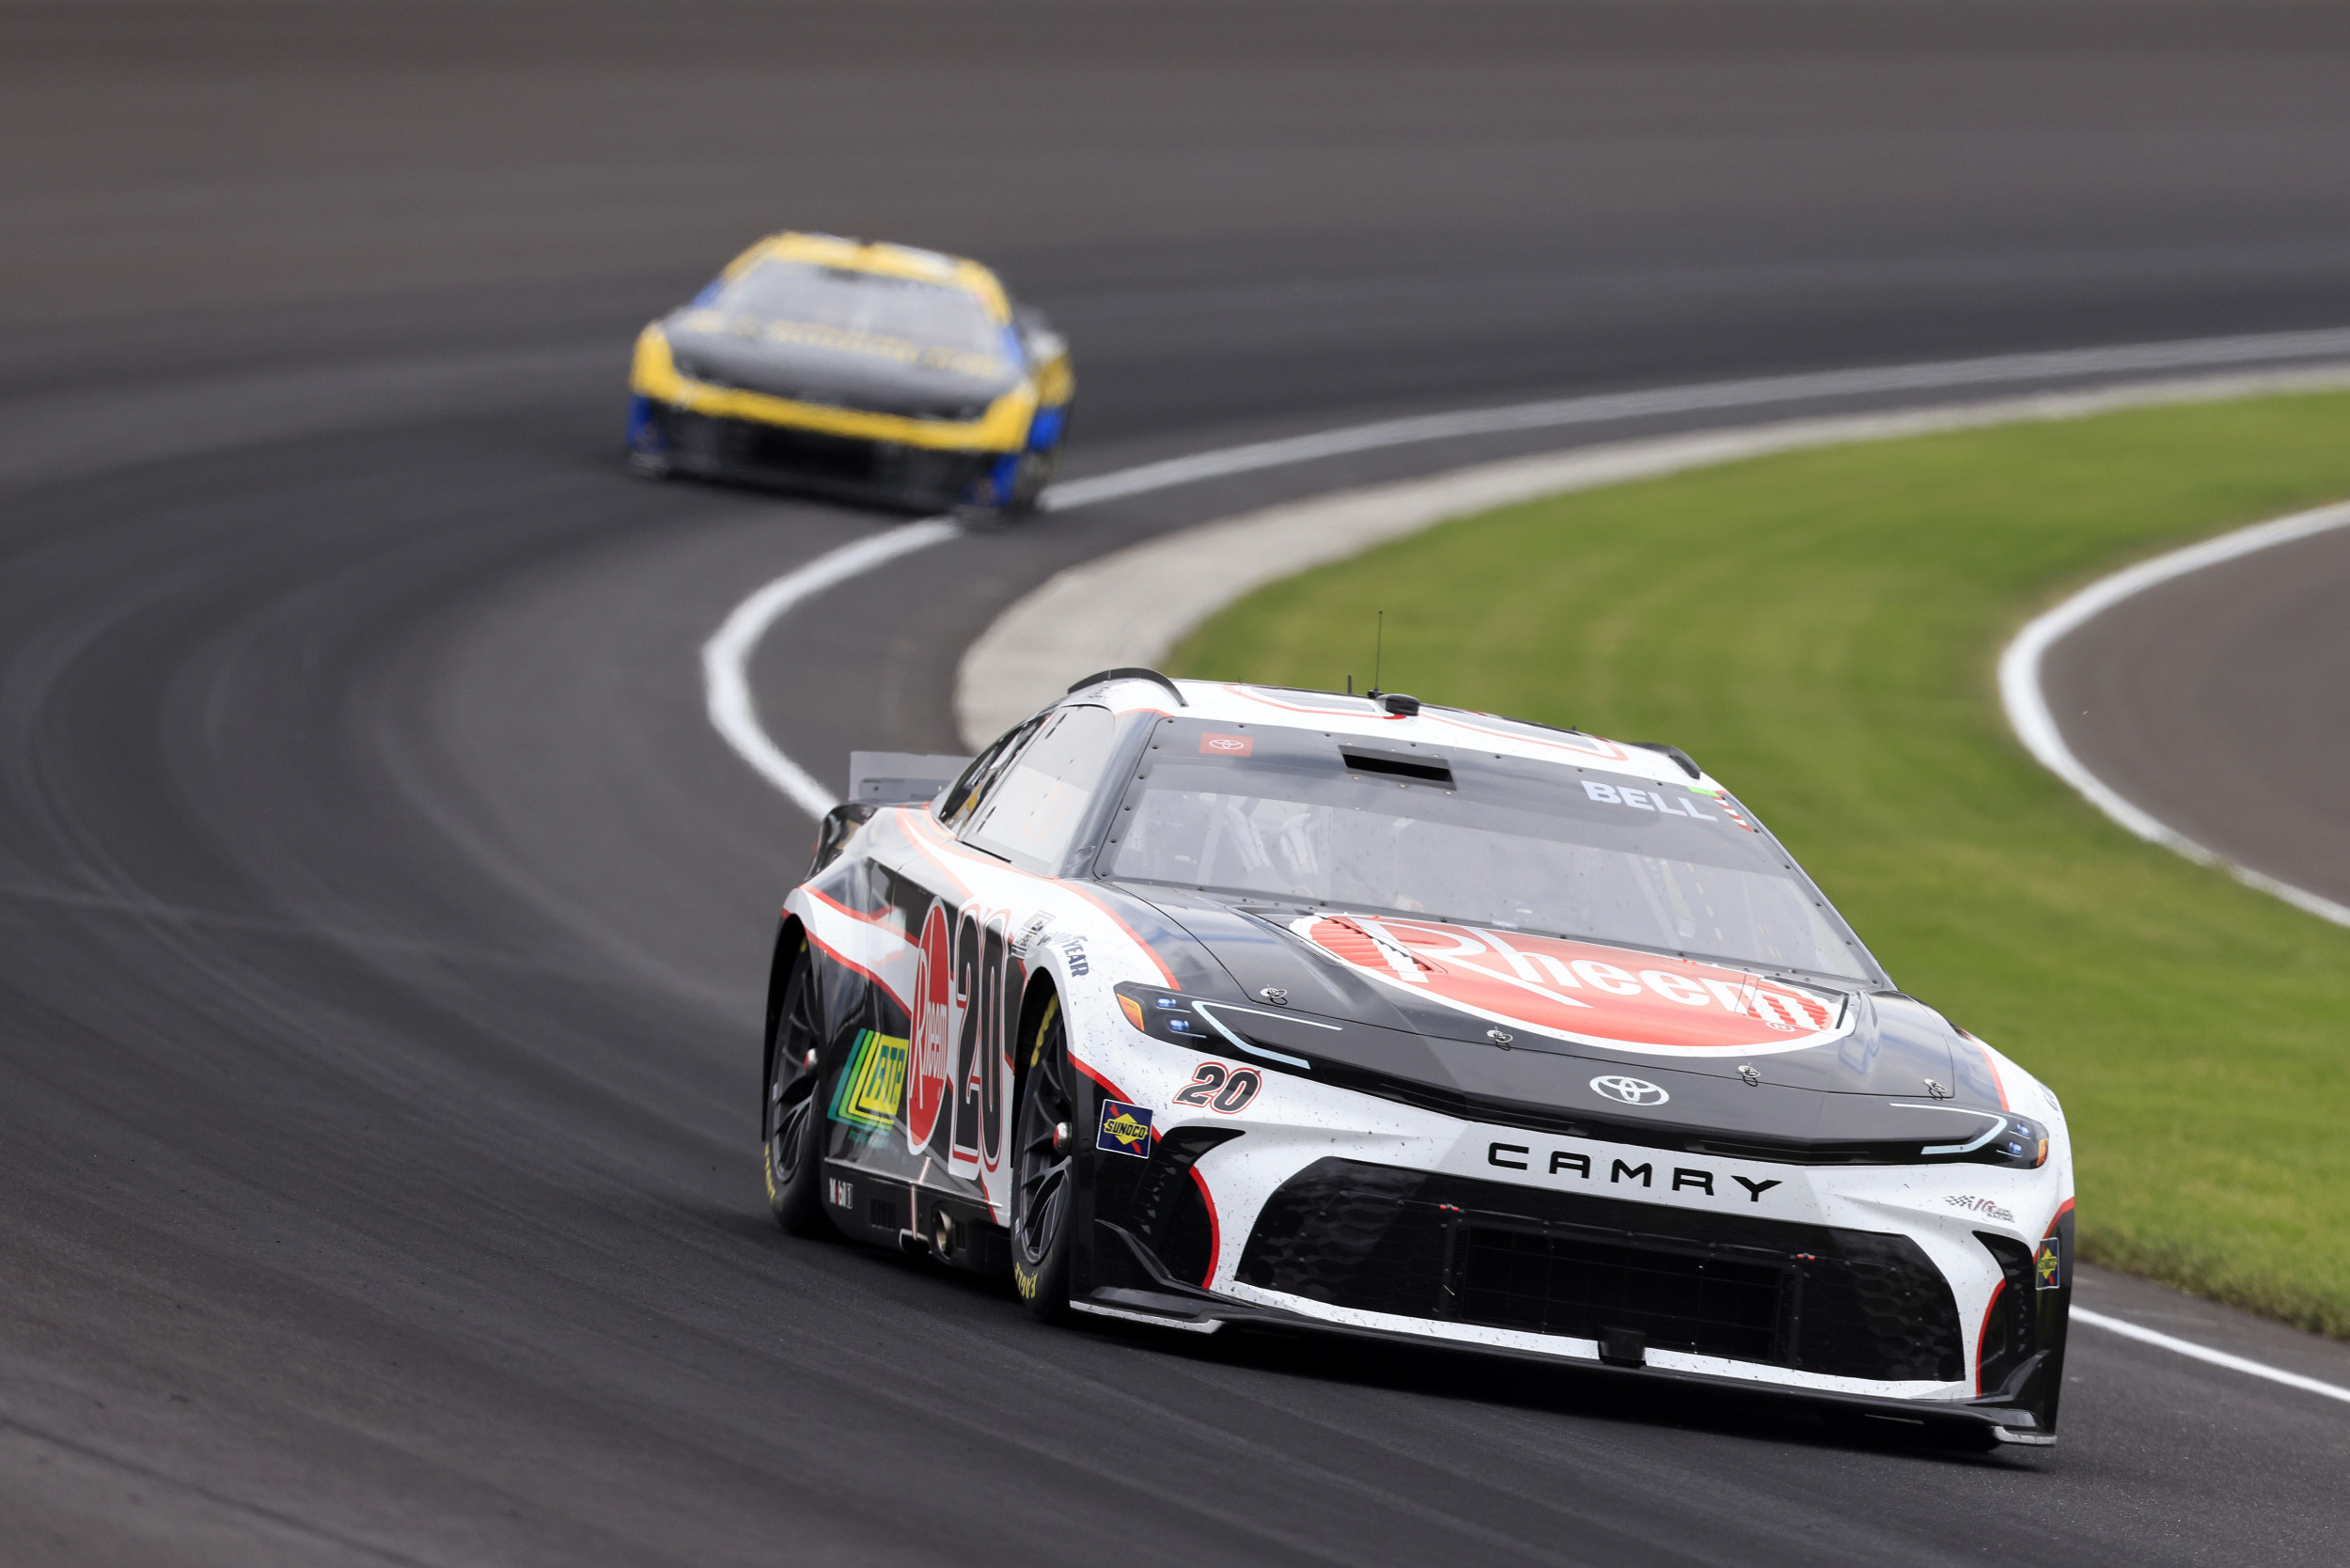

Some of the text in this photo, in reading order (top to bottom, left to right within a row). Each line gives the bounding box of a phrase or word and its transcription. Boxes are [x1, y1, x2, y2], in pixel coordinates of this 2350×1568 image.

[1580, 779, 1718, 823] BELL
[1350, 916, 1822, 1032] Rheem
[909, 908, 947, 1110] Rheem
[951, 902, 1011, 1173] 20
[1172, 1061, 1262, 1115] 20
[1105, 1120, 1147, 1139] SUNOCO
[1488, 1142, 1783, 1202] CAMRY
